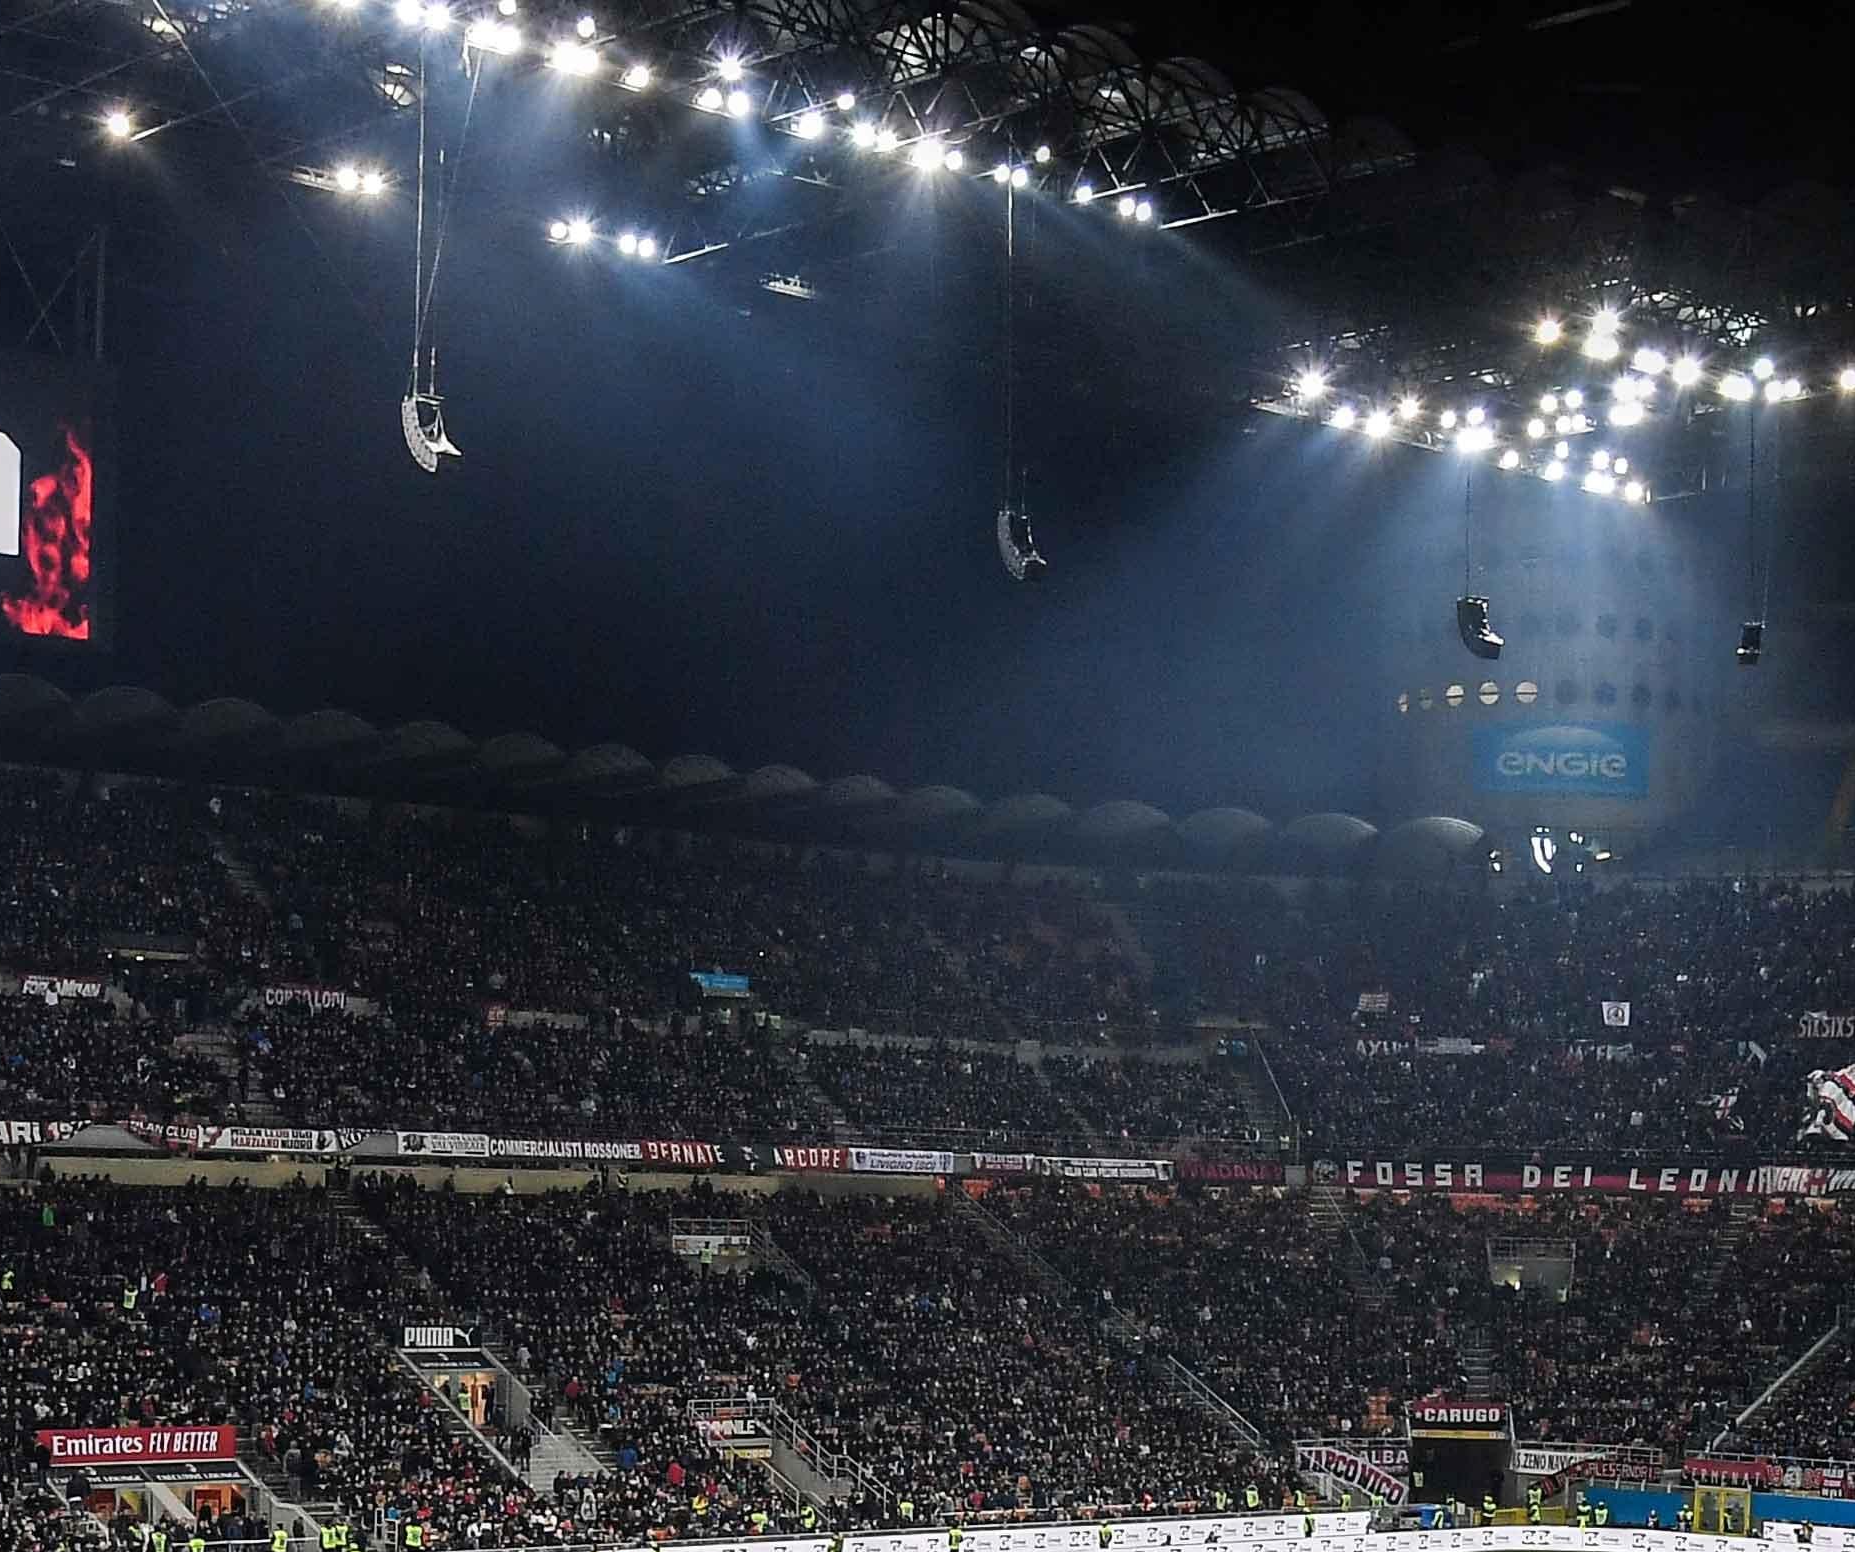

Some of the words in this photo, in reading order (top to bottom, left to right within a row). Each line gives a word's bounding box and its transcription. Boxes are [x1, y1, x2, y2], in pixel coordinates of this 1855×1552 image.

[490, 1137, 582, 1160] COMMERCIALISTI
[772, 1147, 841, 1169] ARCORE
[1346, 1160, 1484, 1188] FOSSA
[1522, 1165, 1593, 1189] DEI
[1628, 1167, 1757, 1193] LEONI
[403, 1326, 454, 1348] PUMA
[1424, 1407, 1501, 1423] CARUGO
[51, 1433, 143, 1458] Emirates
[148, 1431, 173, 1455] FLY
[173, 1430, 219, 1454] BETTER
